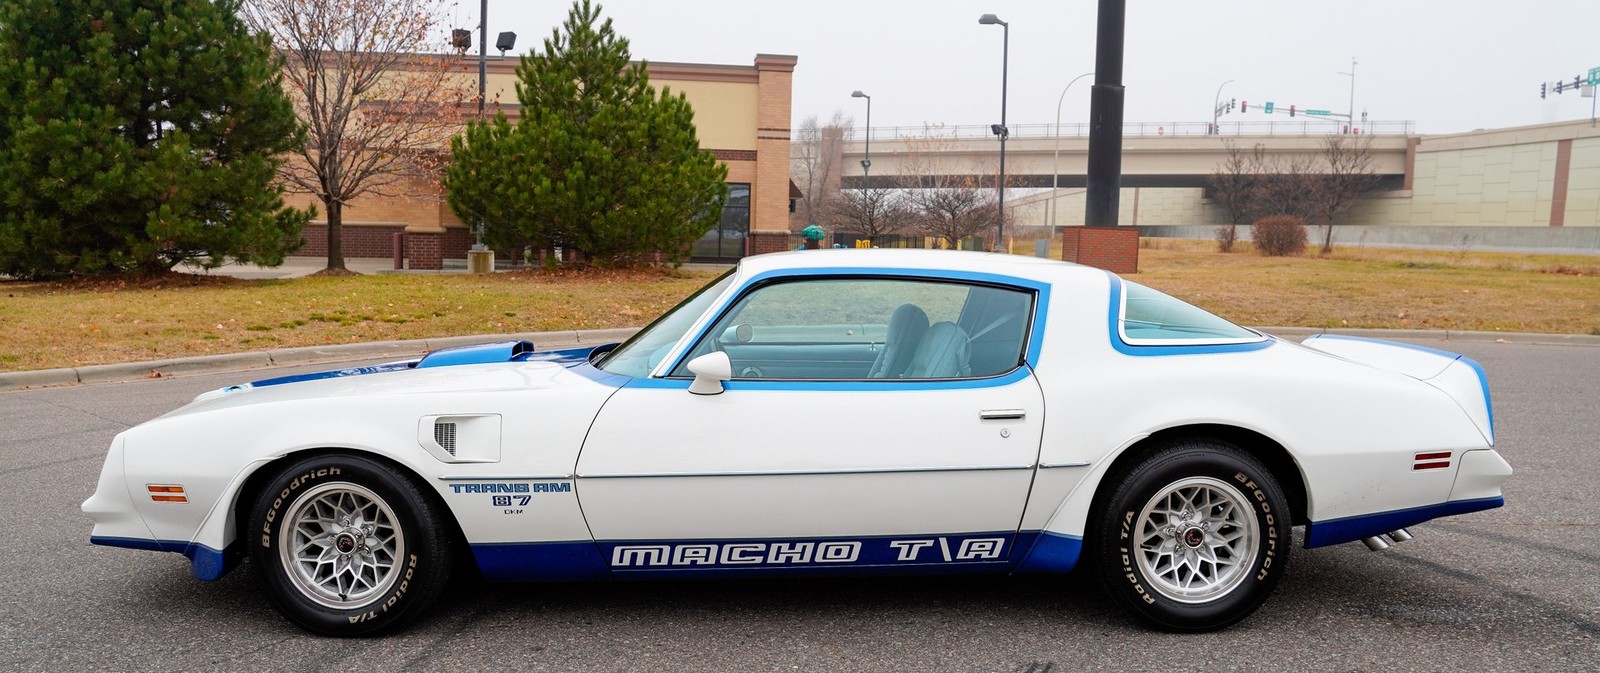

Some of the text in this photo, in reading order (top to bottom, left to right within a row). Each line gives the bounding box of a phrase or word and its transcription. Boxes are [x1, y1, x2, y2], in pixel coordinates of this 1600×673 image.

[262, 466, 341, 548] BFGoodrich
[449, 482, 571, 493] TRANS AM
[492, 495, 532, 507] 87
[611, 541, 862, 566] MACHO
[1120, 511, 1156, 605] Radial T/A
[1234, 472, 1278, 581] BFGoodrich
[348, 553, 418, 624] Radial T/A
